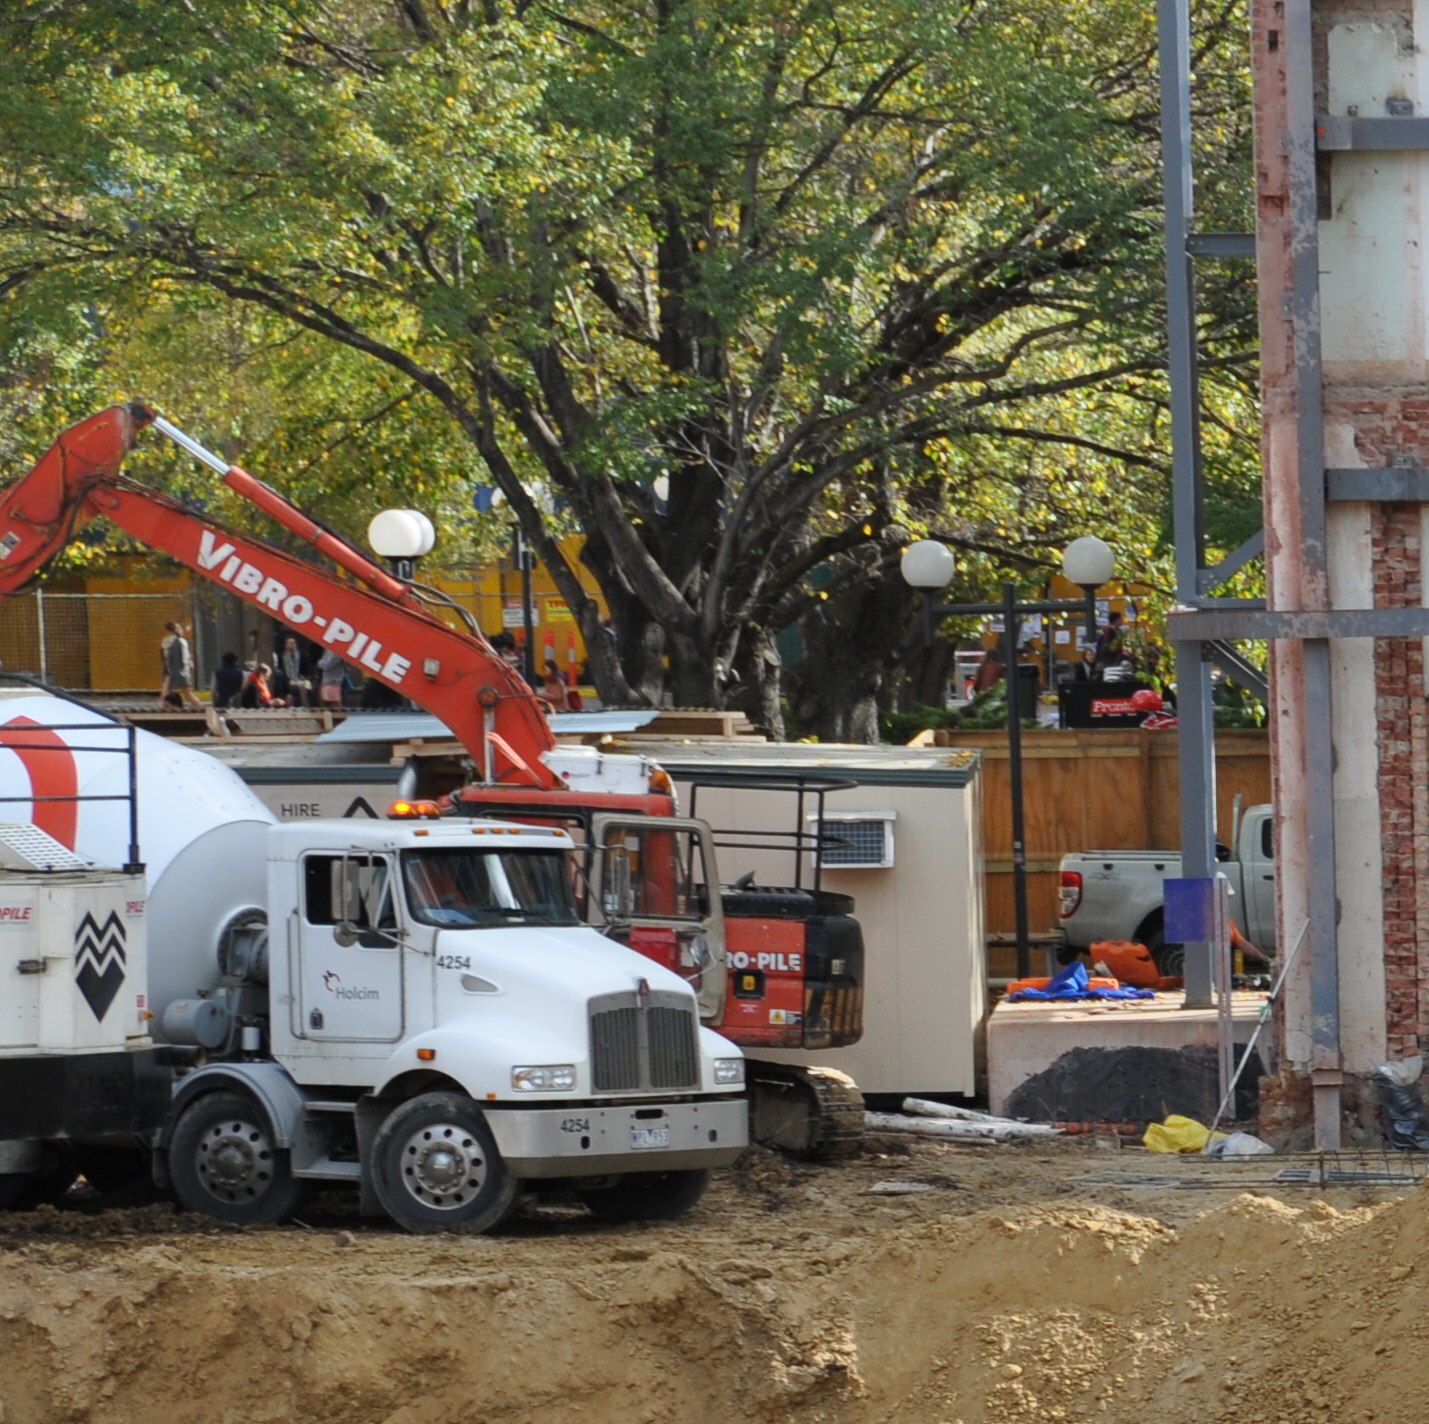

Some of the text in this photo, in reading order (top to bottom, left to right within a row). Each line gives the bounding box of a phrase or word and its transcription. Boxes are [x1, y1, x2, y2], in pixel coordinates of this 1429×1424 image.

[196, 529, 412, 685] VIBRO-PILE
[280, 803, 321, 818] HIRE
[0, 907, 33, 920] PILE
[436, 955, 471, 970] 4254
[335, 986, 380, 1000] Holcim
[560, 1118, 590, 1133] 4254
